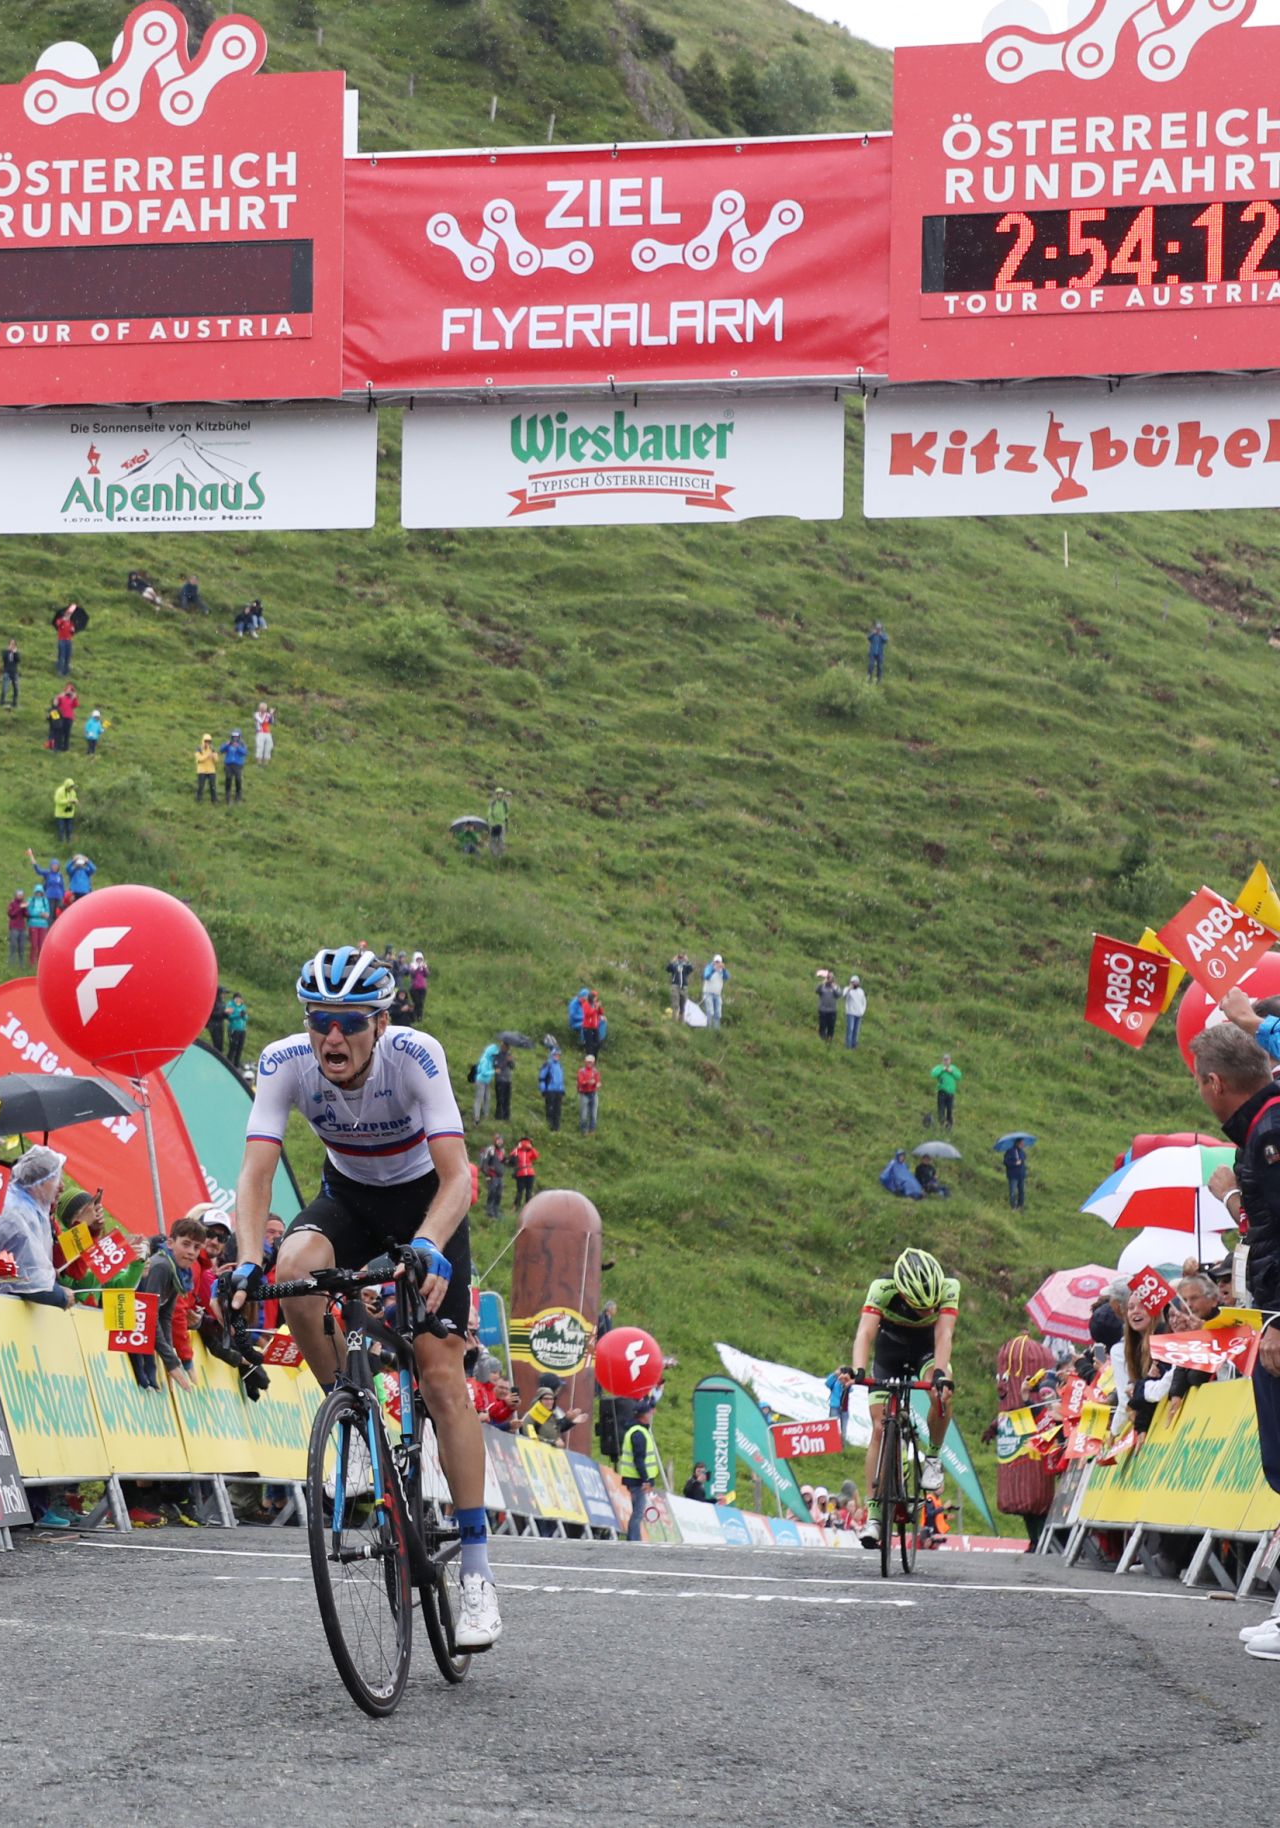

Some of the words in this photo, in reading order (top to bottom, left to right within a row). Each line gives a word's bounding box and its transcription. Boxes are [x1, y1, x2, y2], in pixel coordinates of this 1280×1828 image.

[945, 152, 1280, 204] RUNDFAHRT
[544, 176, 681, 229] ZIEL
[995, 200, 1280, 292] 2:54:12
[944, 293, 1037, 314] TOUR
[1061, 290, 1104, 309] OF
[1125, 282, 1280, 307] AUSTRIA
[91, 321, 130, 341] OF
[149, 317, 293, 339] AUSTRIA
[441, 297, 783, 351] FLYERALARM
[70, 423, 90, 434] Die
[93, 422, 166, 434] Sonnenseite
[169, 424, 192, 432] von
[196, 420, 251, 431] Kitzbühel
[510, 411, 734, 464] Wiesbauer
[531, 476, 589, 494] TYPISCH
[594, 472, 711, 491] ÖSTERREICHISCH
[117, 514, 216, 522] Kitzbüheler
[1104, 952, 1134, 1024] ARBÖ
[1134, 960, 1157, 1007] 1-2-3
[406, 1041, 440, 1080] GAZPROM
[89, 1248, 112, 1275] 1-2-3
[1133, 1274, 1159, 1302] RBÖ
[1143, 1287, 1169, 1310] 1-2-3
[532, 1337, 585, 1355] Wiesbauer
[710, 1403, 733, 1495] Tageszeitung
[791, 1434, 826, 1455] 50m
